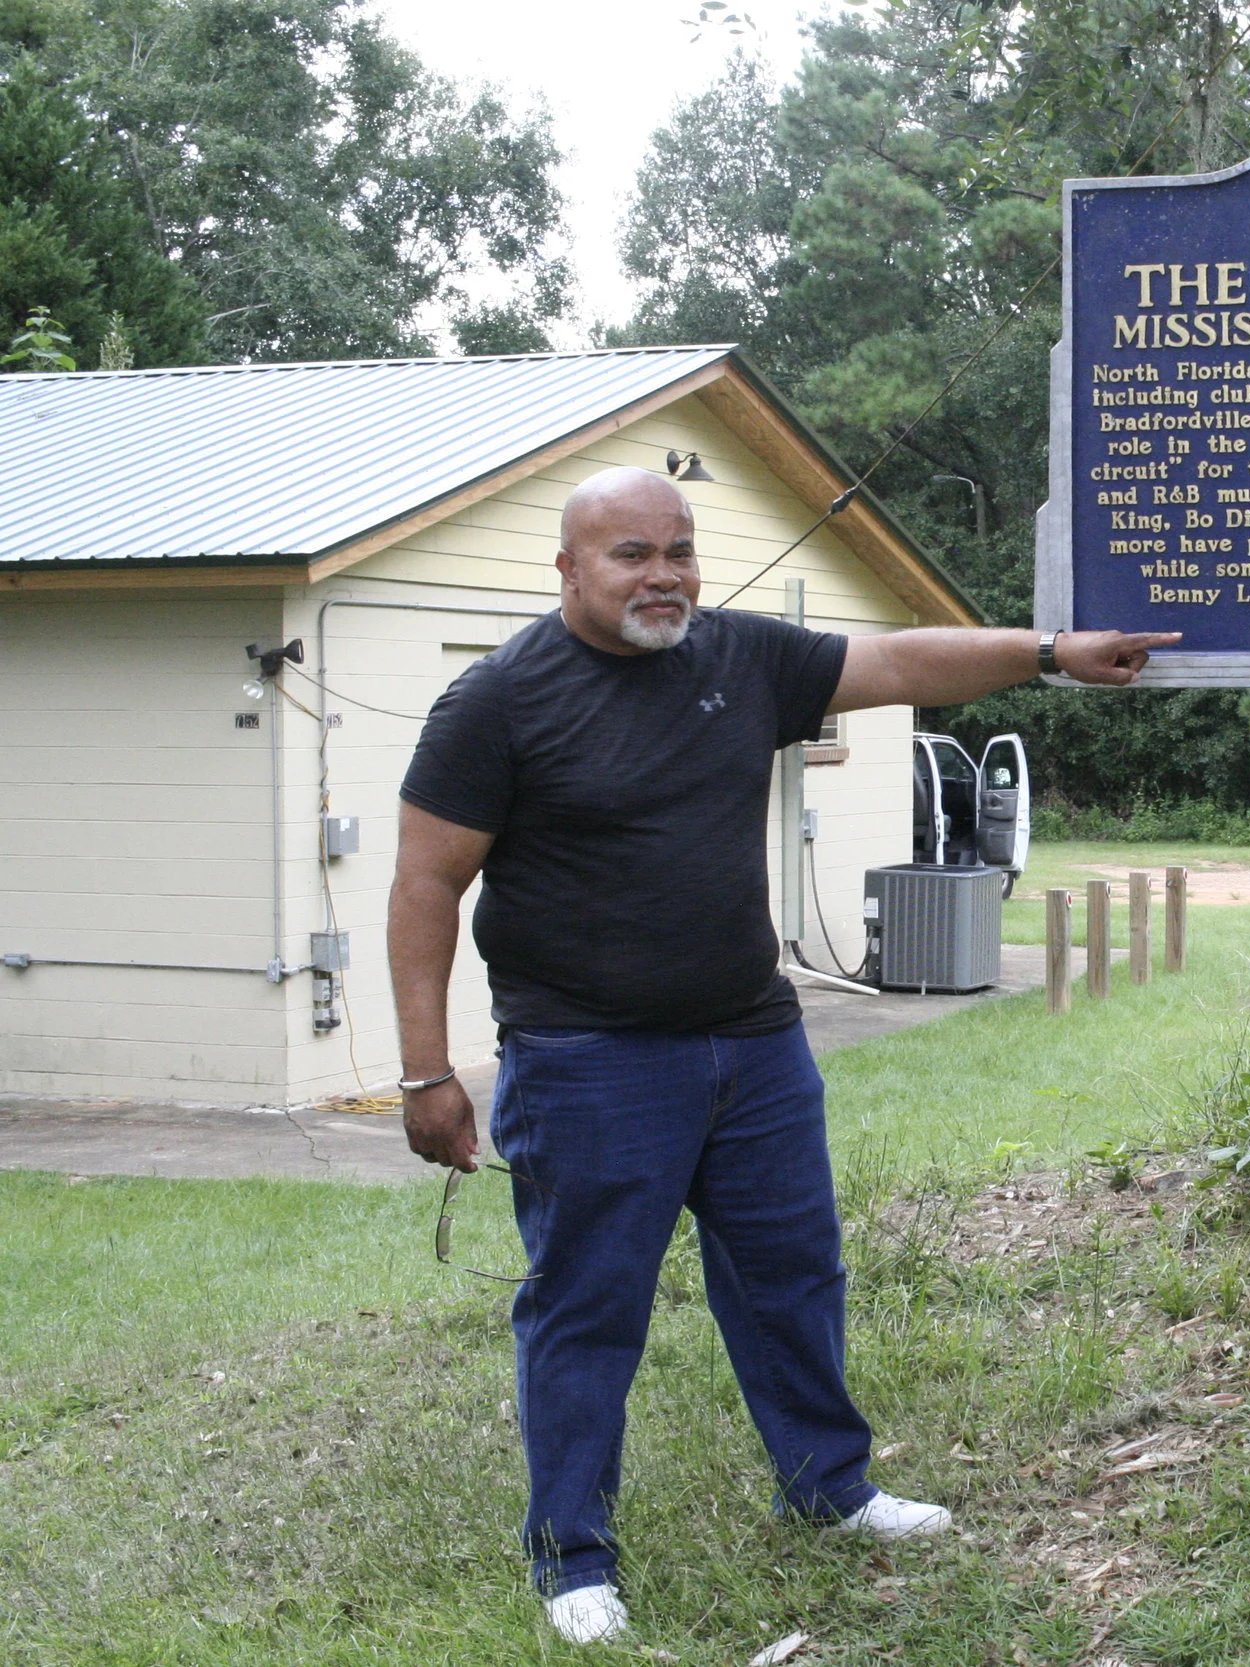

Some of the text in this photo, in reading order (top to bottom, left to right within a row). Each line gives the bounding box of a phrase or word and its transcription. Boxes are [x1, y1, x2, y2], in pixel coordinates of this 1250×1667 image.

[1124, 262, 1247, 307] THE
[1092, 363, 1160, 383] North
[1092, 385, 1199, 408] including
[1107, 436, 1153, 455] role
[1167, 435, 1191, 453] in
[1206, 434, 1247, 453] the
[1197, 459, 1233, 478] for
[1097, 485, 1138, 504] and
[1152, 484, 1201, 504] R&B
[1111, 510, 1171, 533] King,
[1185, 508, 1214, 528] Bo
[1109, 539, 1167, 553] more
[1179, 534, 1233, 552] have
[1139, 559, 1200, 577] while
[1149, 583, 1222, 605] Benny
